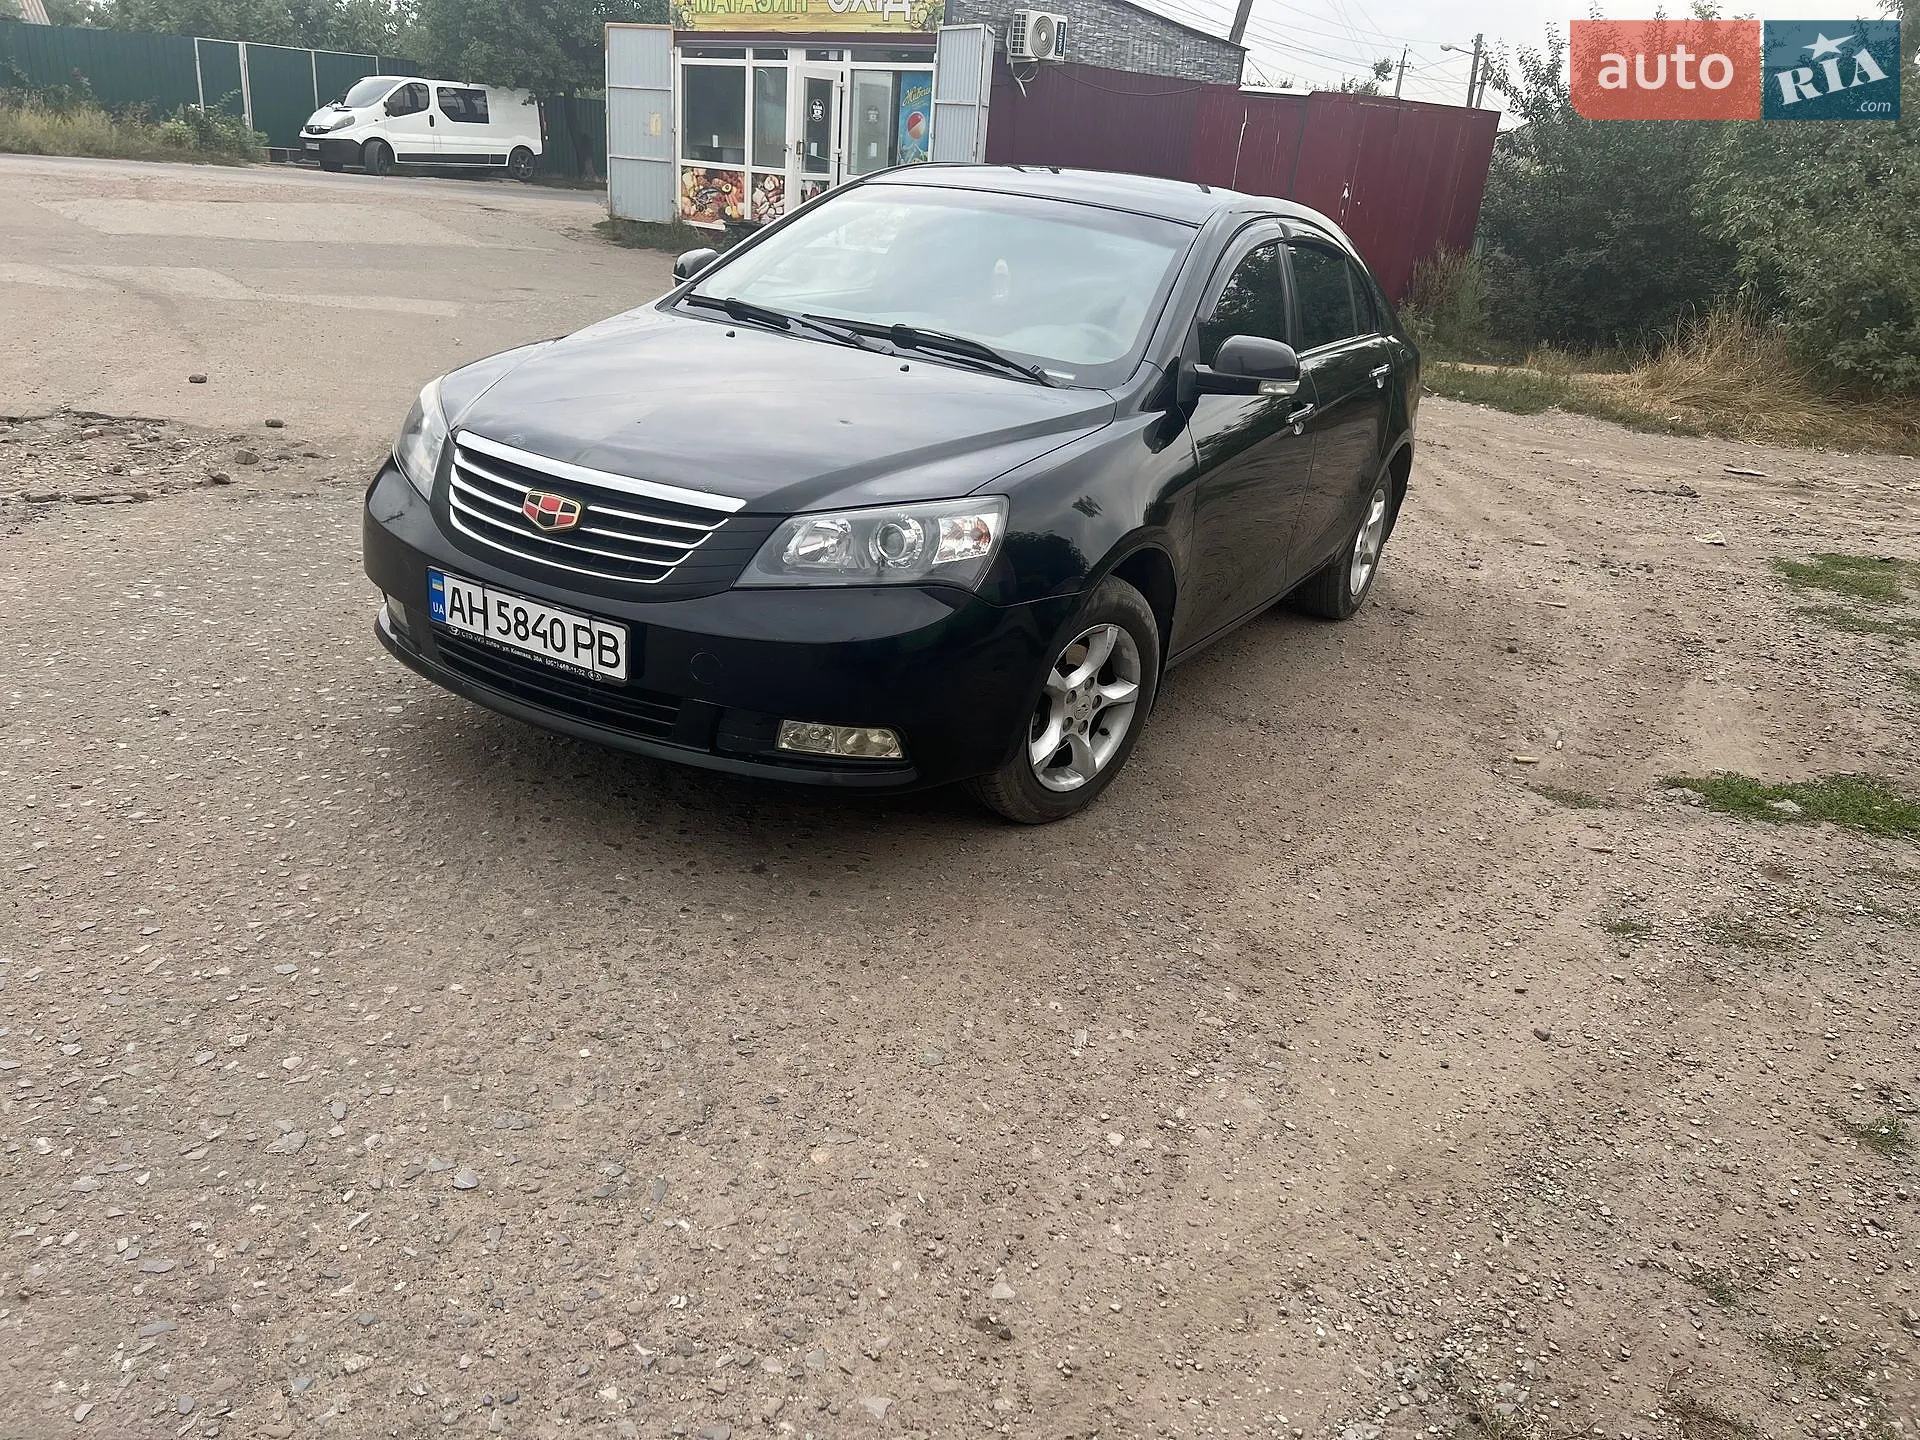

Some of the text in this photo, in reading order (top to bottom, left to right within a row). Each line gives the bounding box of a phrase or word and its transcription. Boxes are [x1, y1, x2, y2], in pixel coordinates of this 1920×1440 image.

[433, 602, 445, 615] UA
[449, 587, 620, 669] AH 5840 PB
